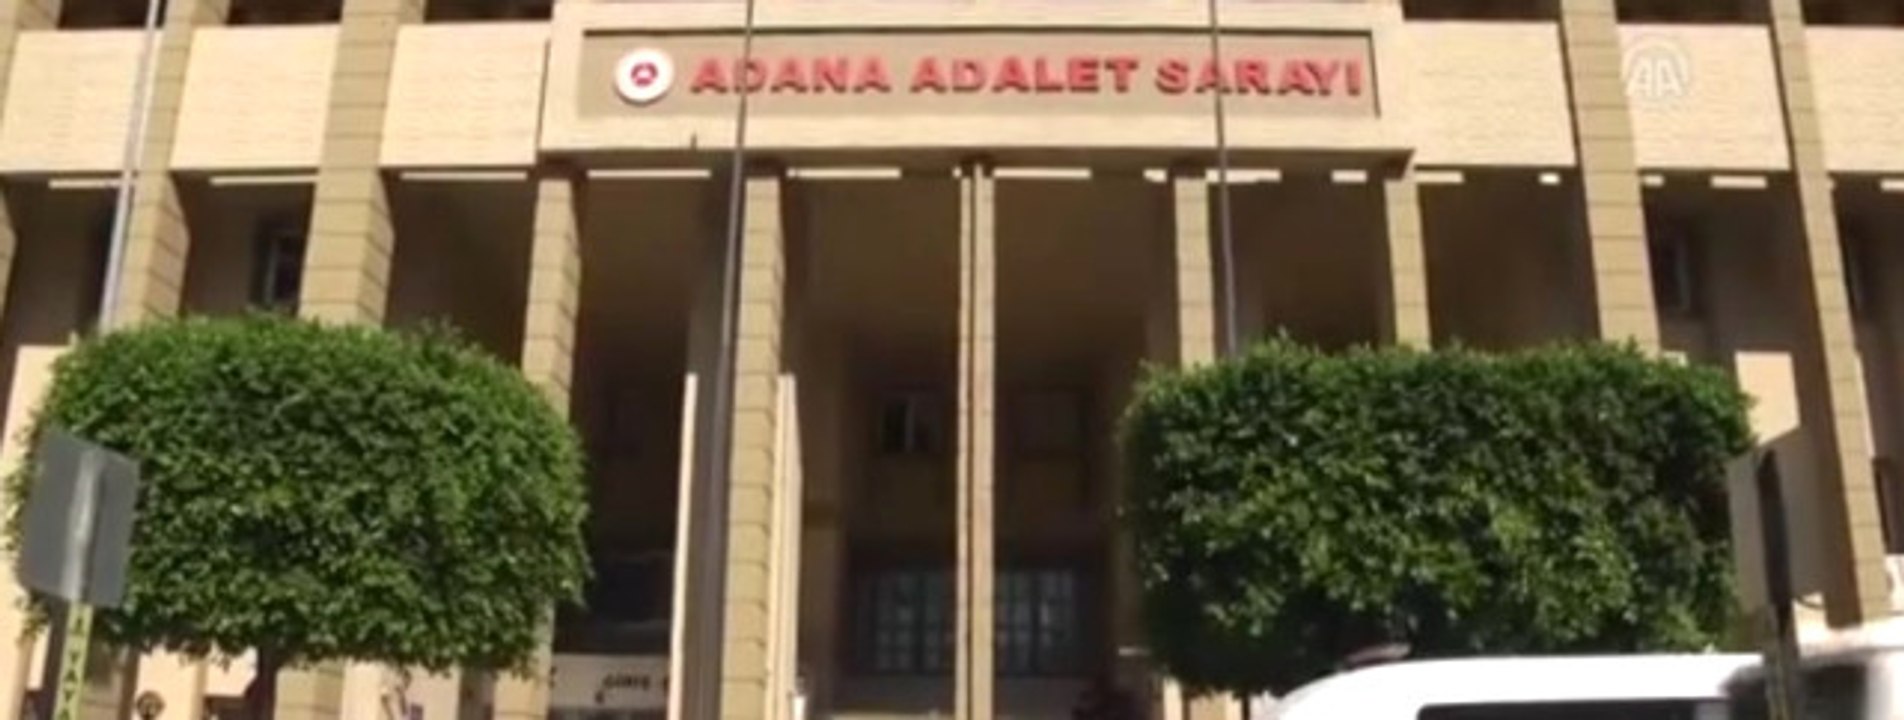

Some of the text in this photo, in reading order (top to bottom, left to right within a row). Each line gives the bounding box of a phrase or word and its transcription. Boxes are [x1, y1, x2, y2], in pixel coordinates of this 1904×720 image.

[690, 55, 1363, 97] ADANA ADALET SARAYI
